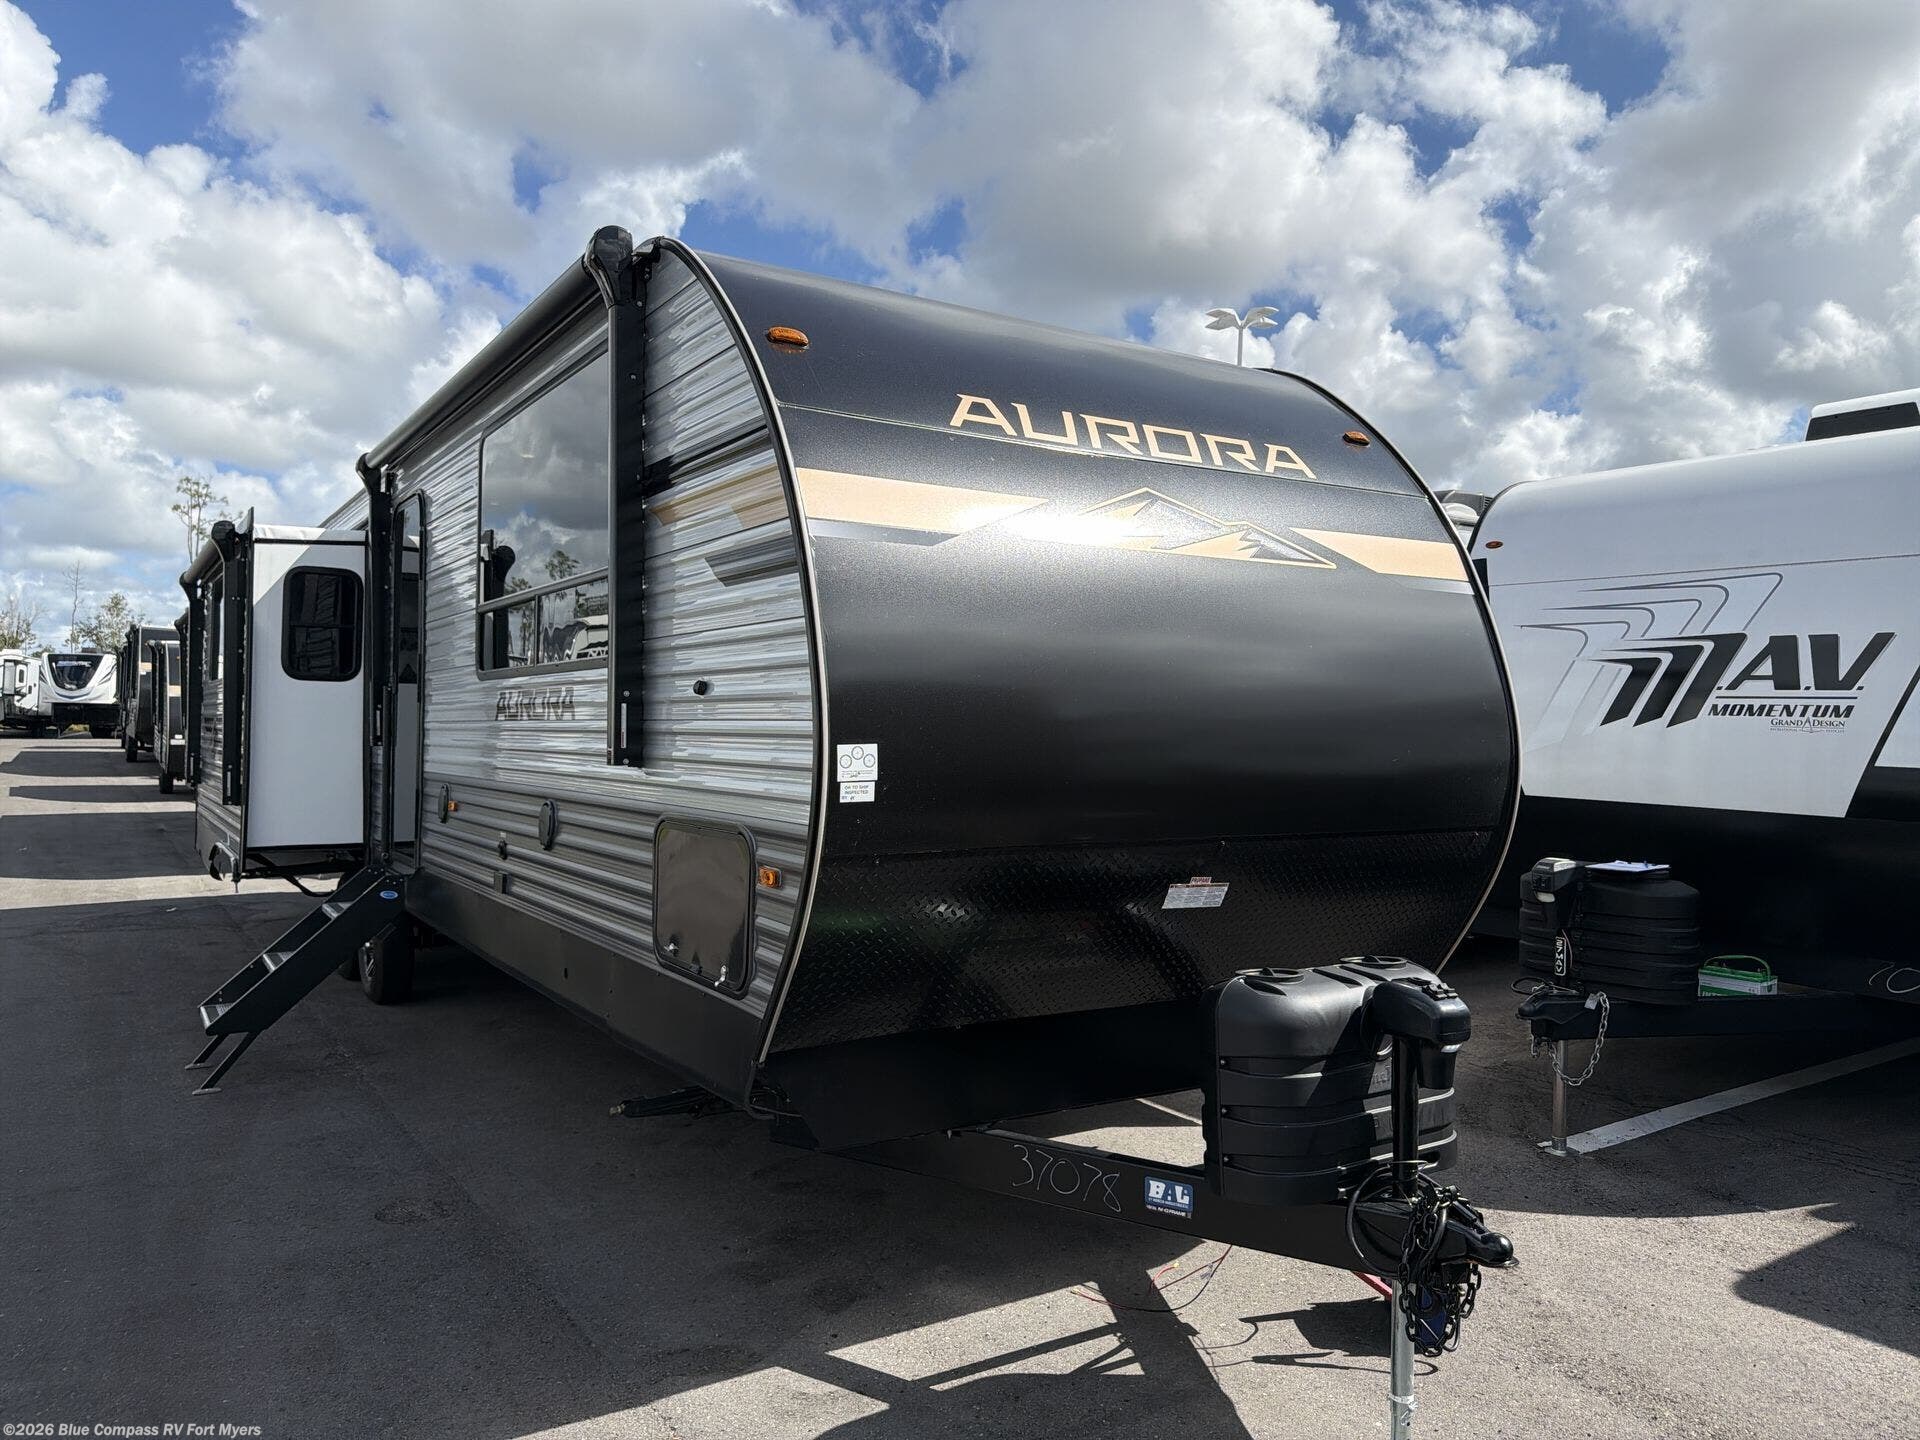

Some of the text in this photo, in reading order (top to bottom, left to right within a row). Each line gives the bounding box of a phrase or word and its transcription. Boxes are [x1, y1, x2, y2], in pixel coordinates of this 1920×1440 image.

[949, 393, 1318, 480] AURORA
[495, 686, 576, 721] AURORA
[1707, 703, 1855, 718] MOMENTUM
[1012, 1144, 1122, 1213] 37078
[1148, 1180, 1190, 1205] BAL
